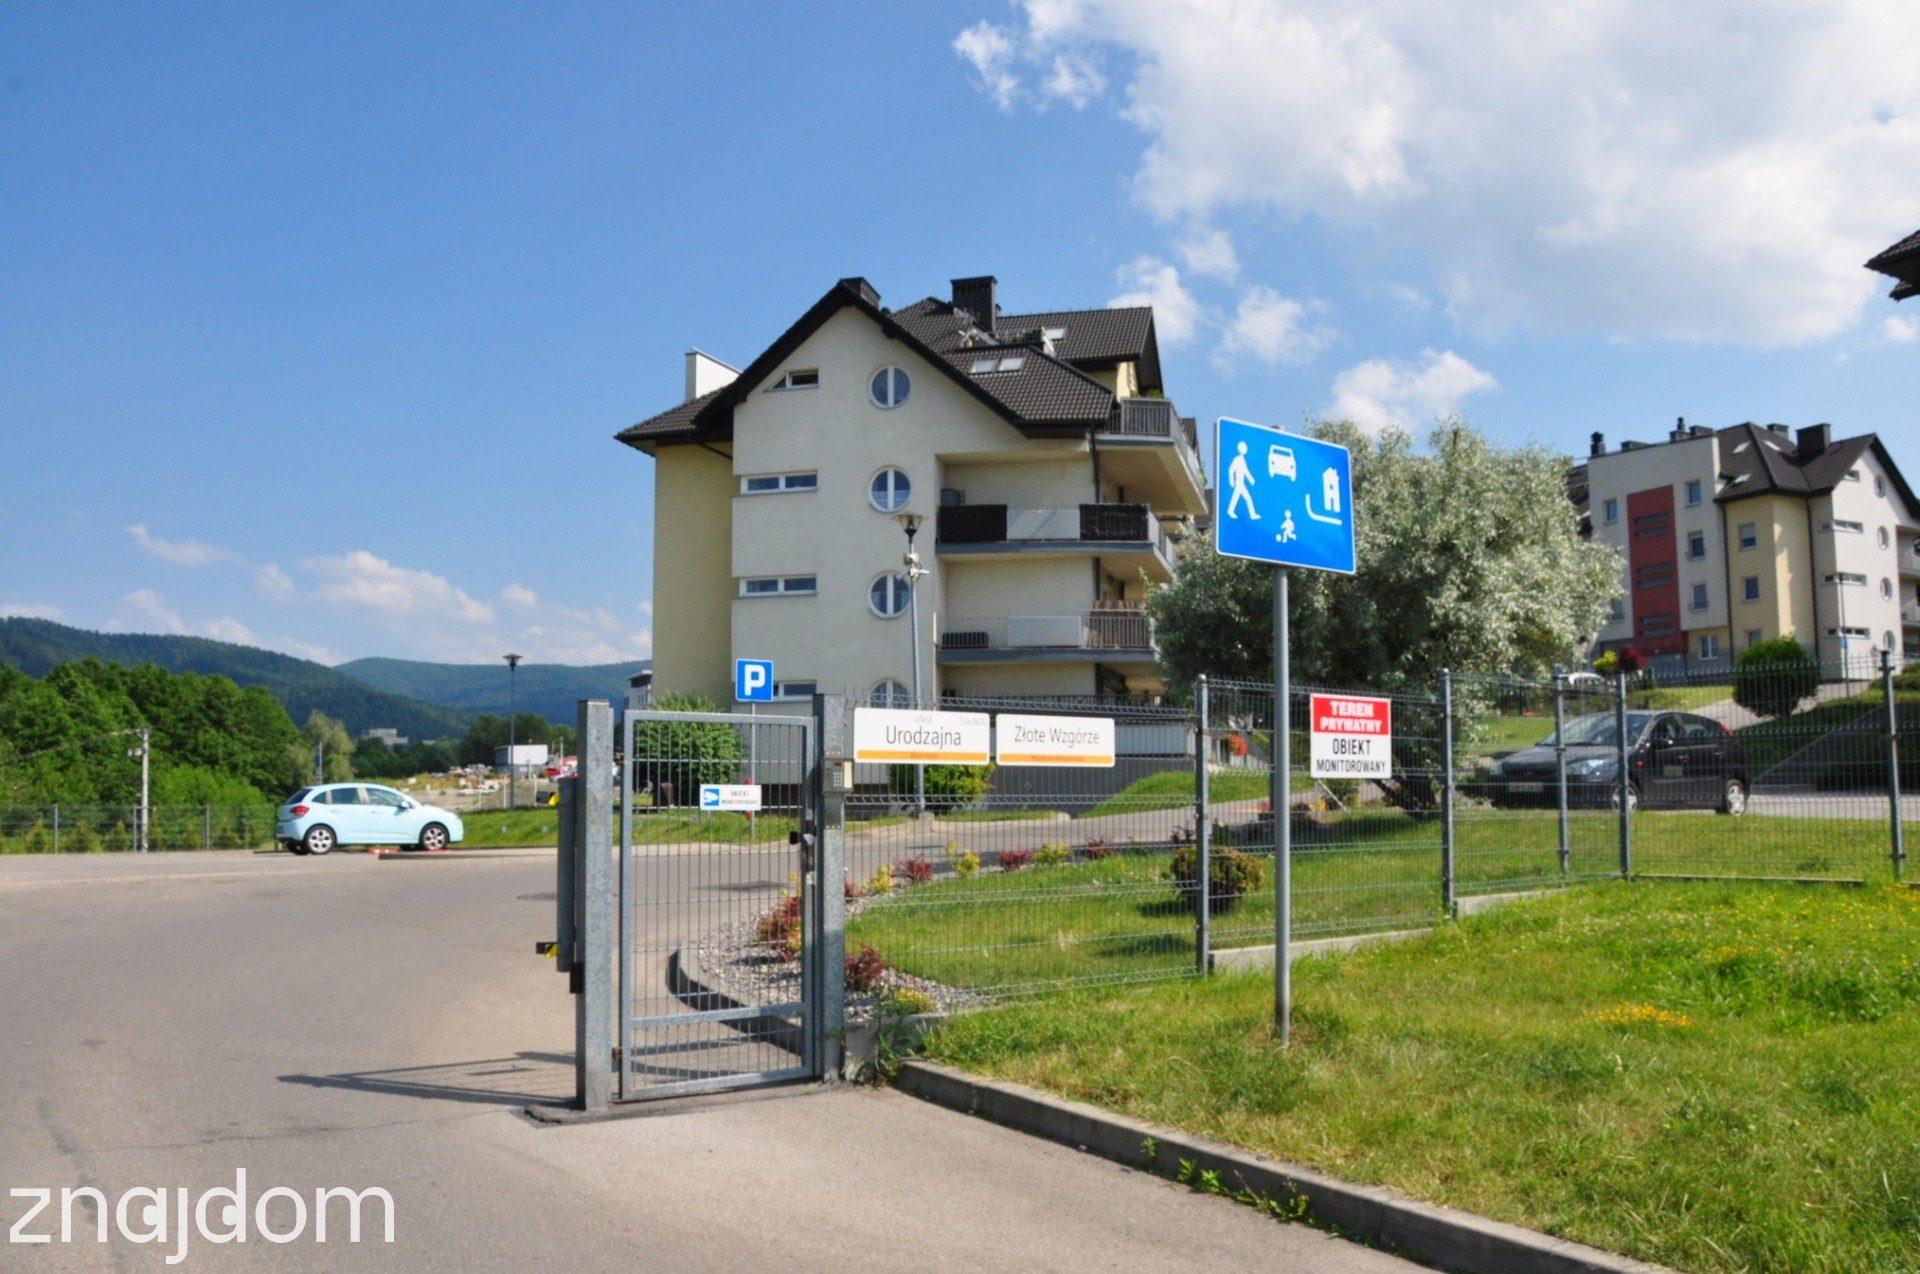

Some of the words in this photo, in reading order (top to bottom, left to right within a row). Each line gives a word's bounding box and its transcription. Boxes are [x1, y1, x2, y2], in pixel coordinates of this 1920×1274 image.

[744, 664, 766, 696] P
[1330, 701, 1374, 717] TEREN
[1320, 716, 1382, 733] PRYWATNY
[885, 725, 962, 749] Urodzajna
[1014, 725, 1046, 743] Złote
[1049, 727, 1100, 748] Wzgórze
[1332, 738, 1371, 755] OBIEKT
[1316, 758, 1386, 772] MONITOROWANY
